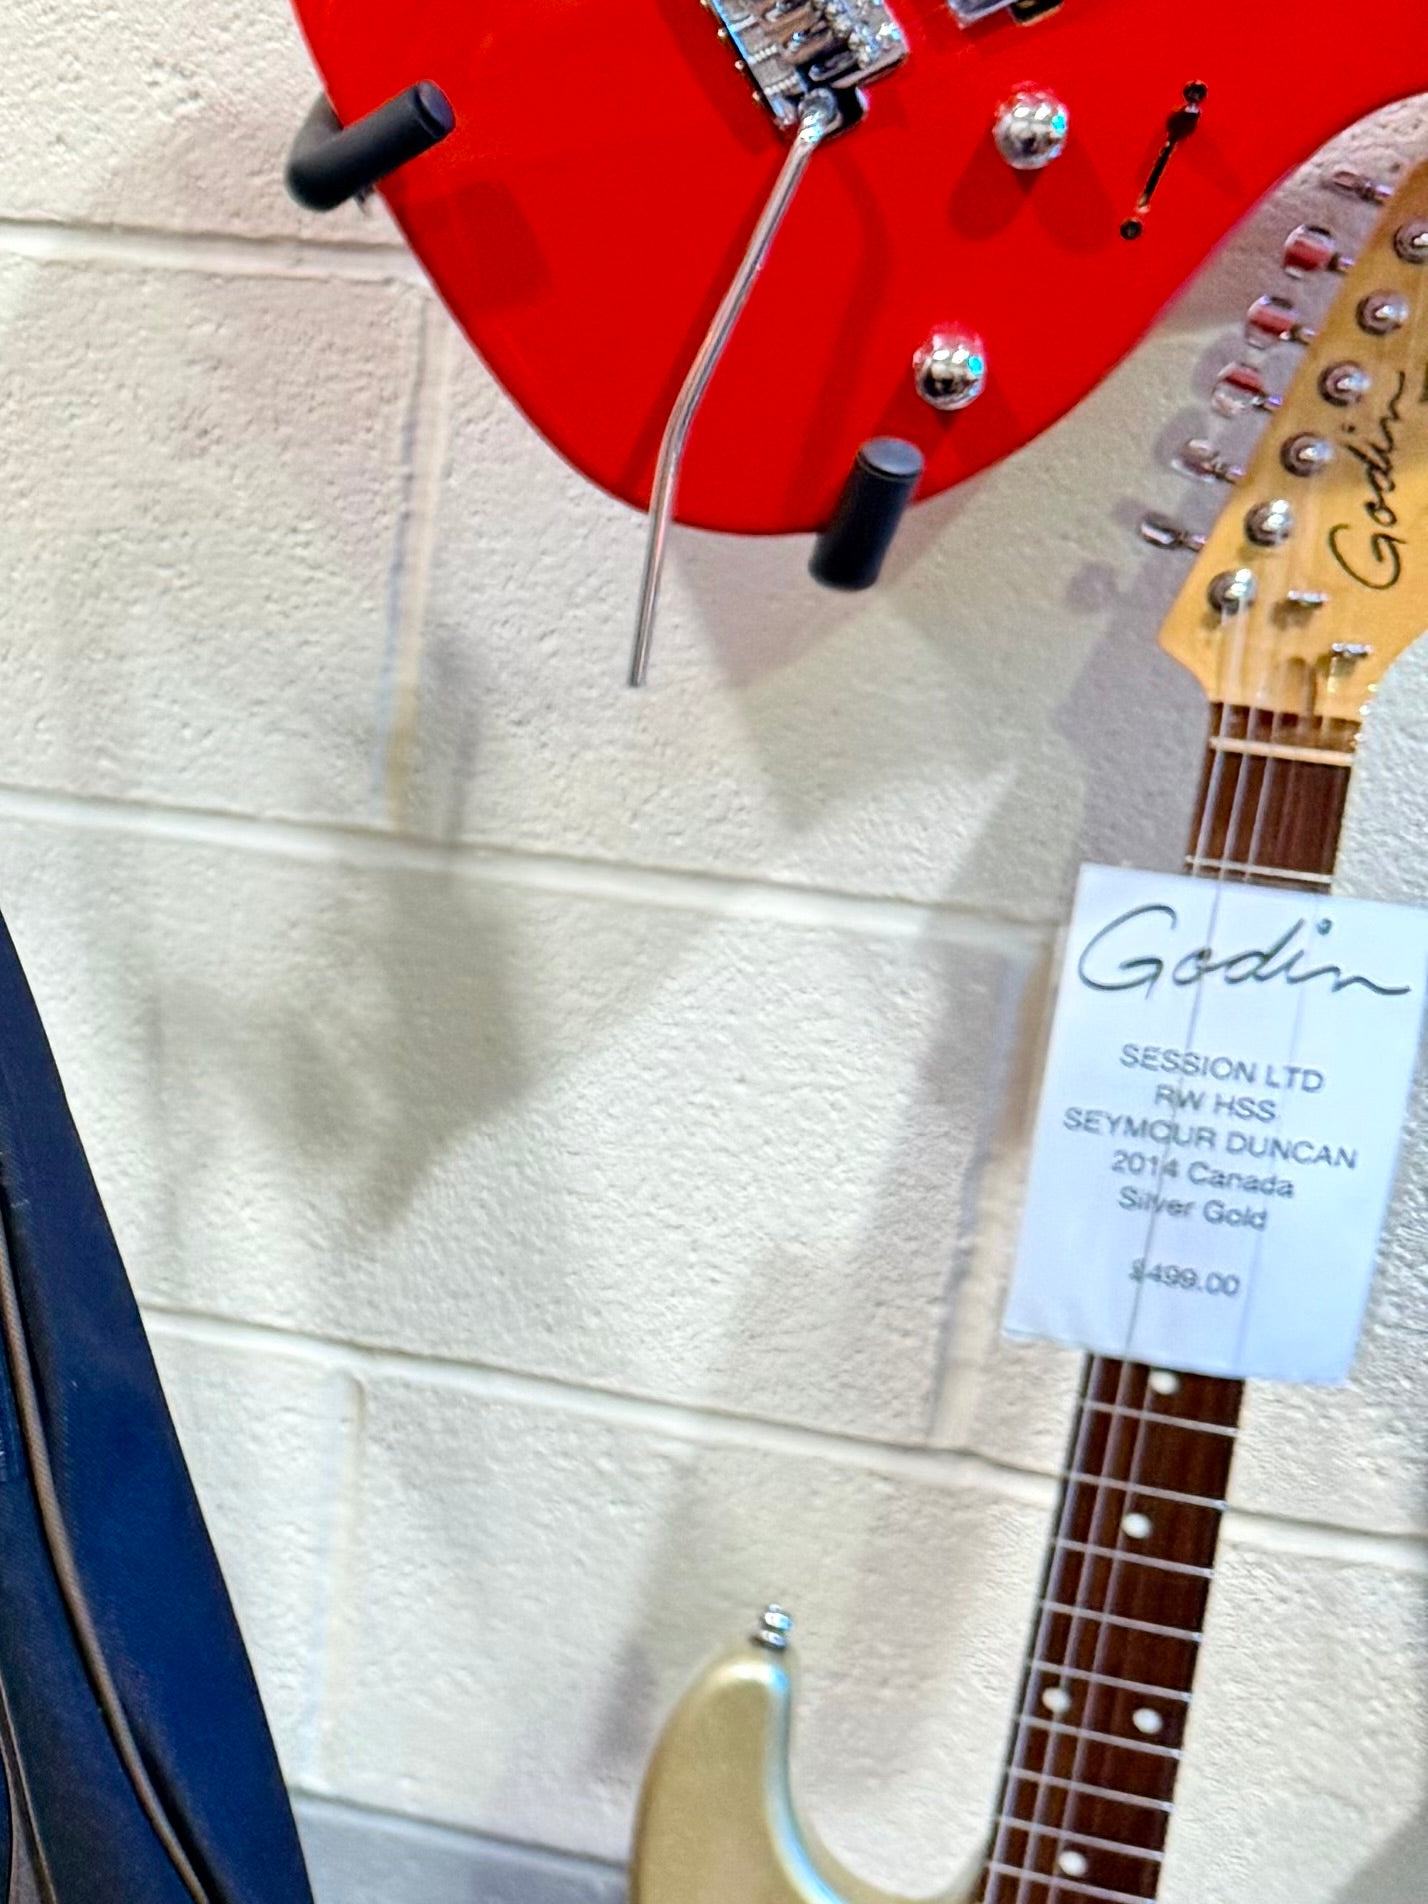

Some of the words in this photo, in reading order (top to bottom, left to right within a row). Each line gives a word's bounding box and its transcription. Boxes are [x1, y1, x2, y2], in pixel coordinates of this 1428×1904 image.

[1328, 370, 1409, 591] Godin
[1077, 902, 1412, 1001] Godin
[1118, 1042, 1257, 1084] SESSION
[1265, 1064, 1325, 1094] LTD
[1153, 1083, 1206, 1112] RW
[1213, 1092, 1277, 1123] HSS
[1062, 1106, 1217, 1152] SEYMOUR
[1226, 1130, 1358, 1170] DUNCAN
[1111, 1148, 1180, 1178] 2014
[1187, 1160, 1295, 1199] Canada
[1117, 1184, 1195, 1218] Silver
[1202, 1198, 1269, 1232] Gold
